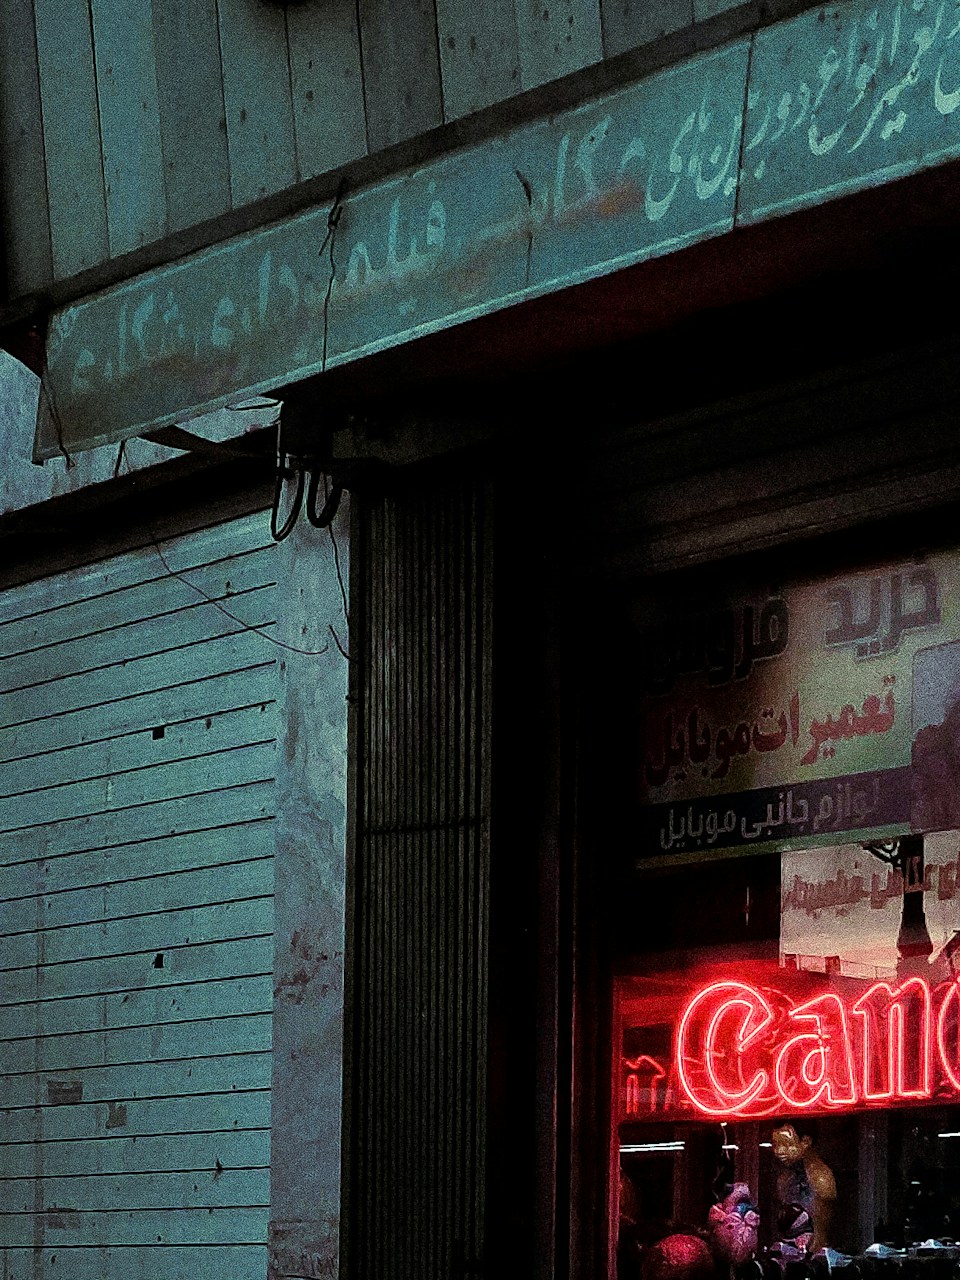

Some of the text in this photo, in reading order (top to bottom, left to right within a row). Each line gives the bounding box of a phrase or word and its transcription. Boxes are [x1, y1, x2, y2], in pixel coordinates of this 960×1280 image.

[644, 675, 896, 787] تعمیرات موبایل
[658, 808, 736, 851] موبایل
[741, 790, 809, 838] جانبی
